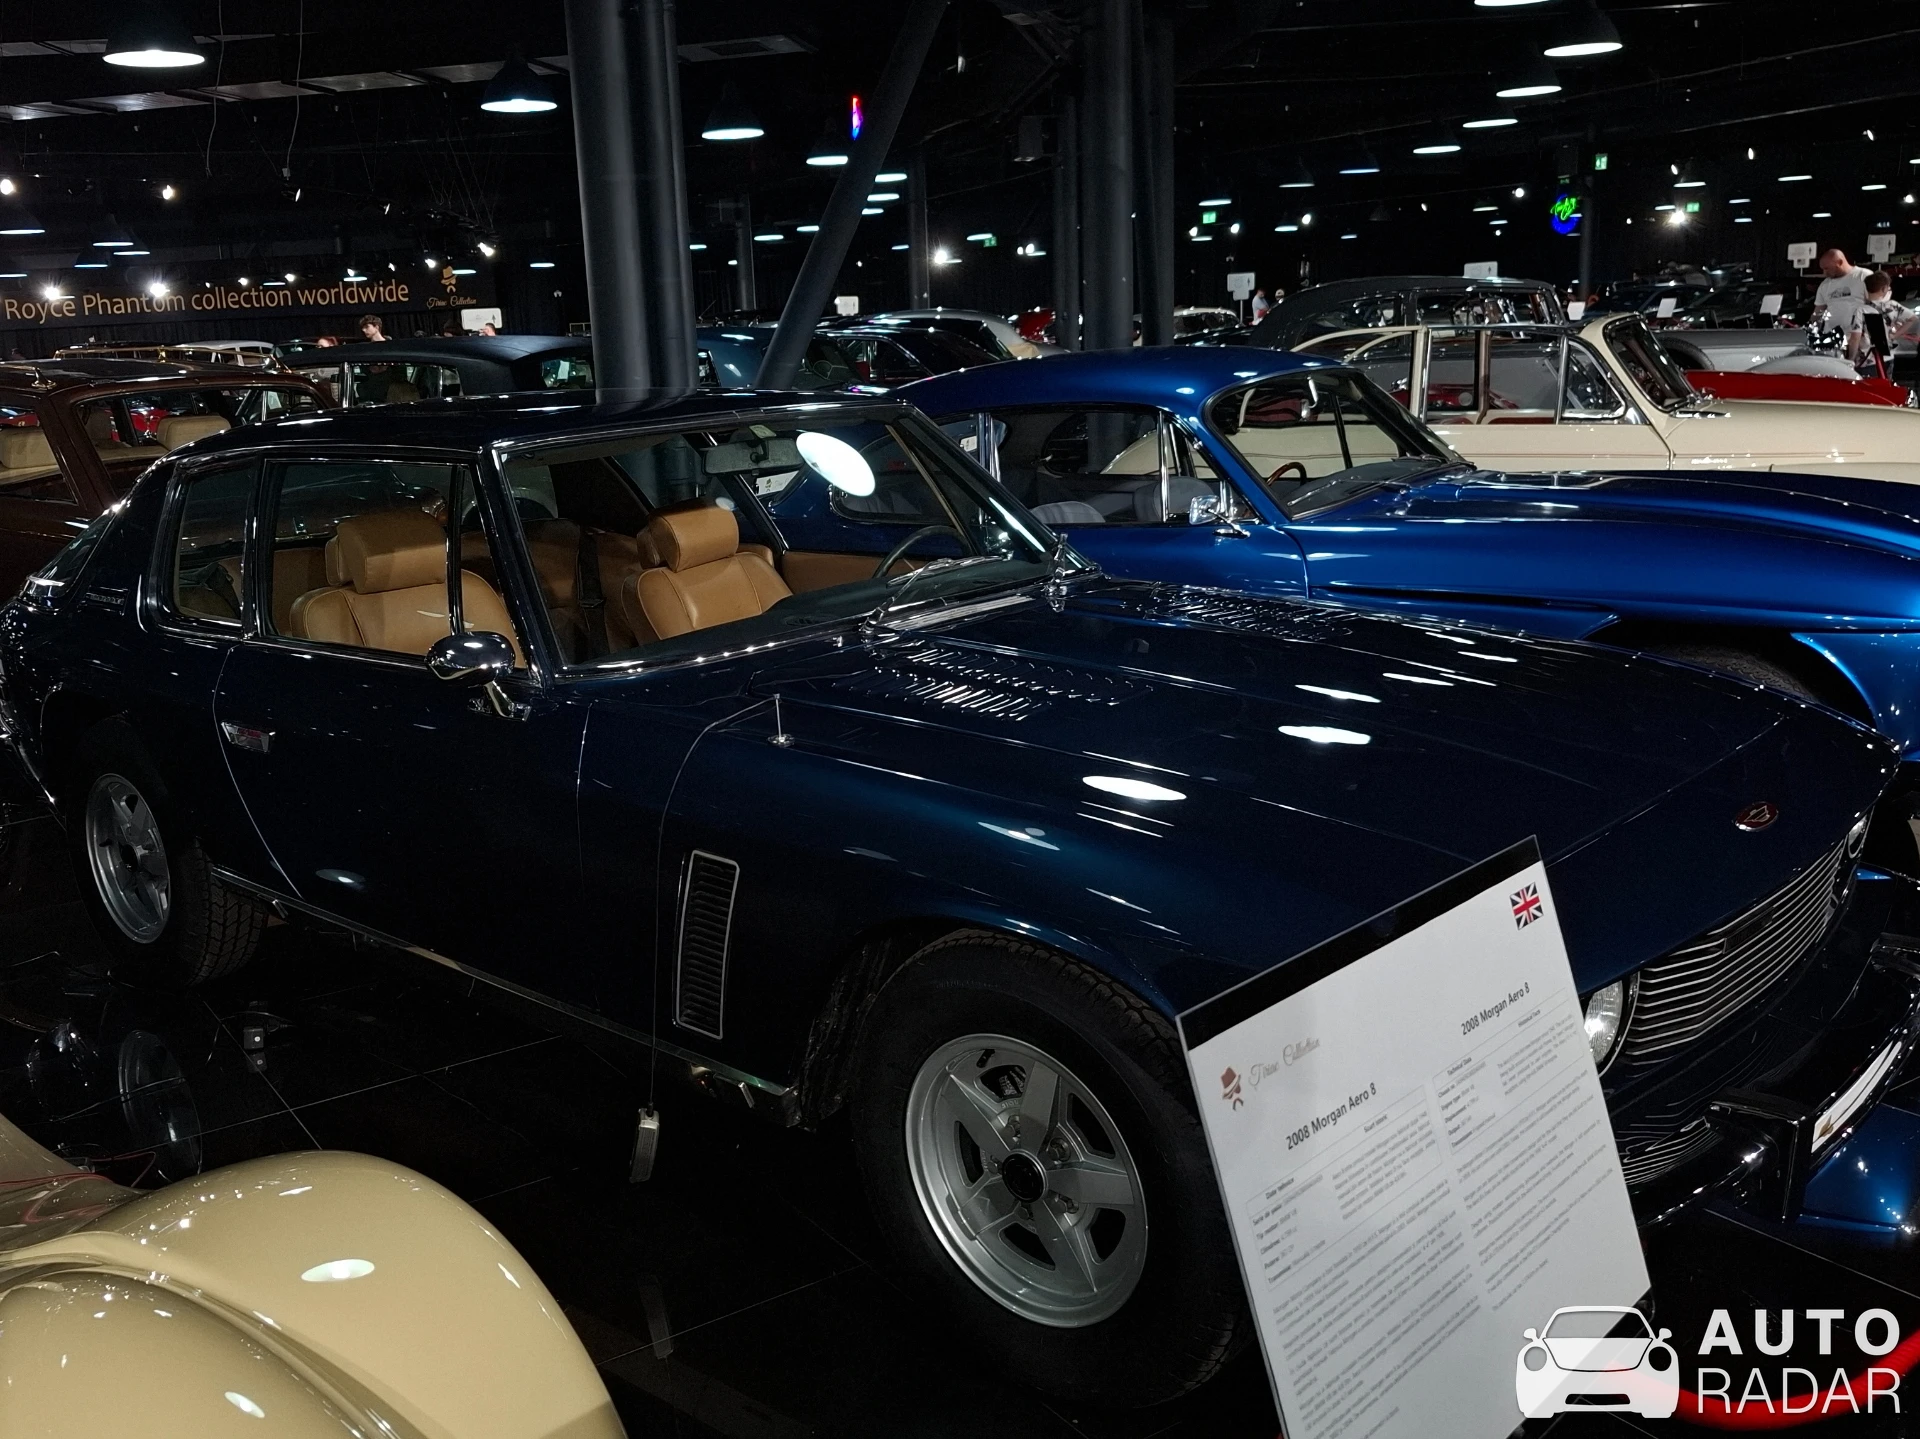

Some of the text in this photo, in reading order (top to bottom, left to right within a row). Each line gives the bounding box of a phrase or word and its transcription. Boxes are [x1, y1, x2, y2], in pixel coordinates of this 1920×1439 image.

[5, 279, 409, 324] Royce Phantom collection worldwide
[1461, 981, 1530, 1036] 2008 Morgan Aero 8
[1286, 1082, 1377, 1150] 2008 Morgan Aero 8
